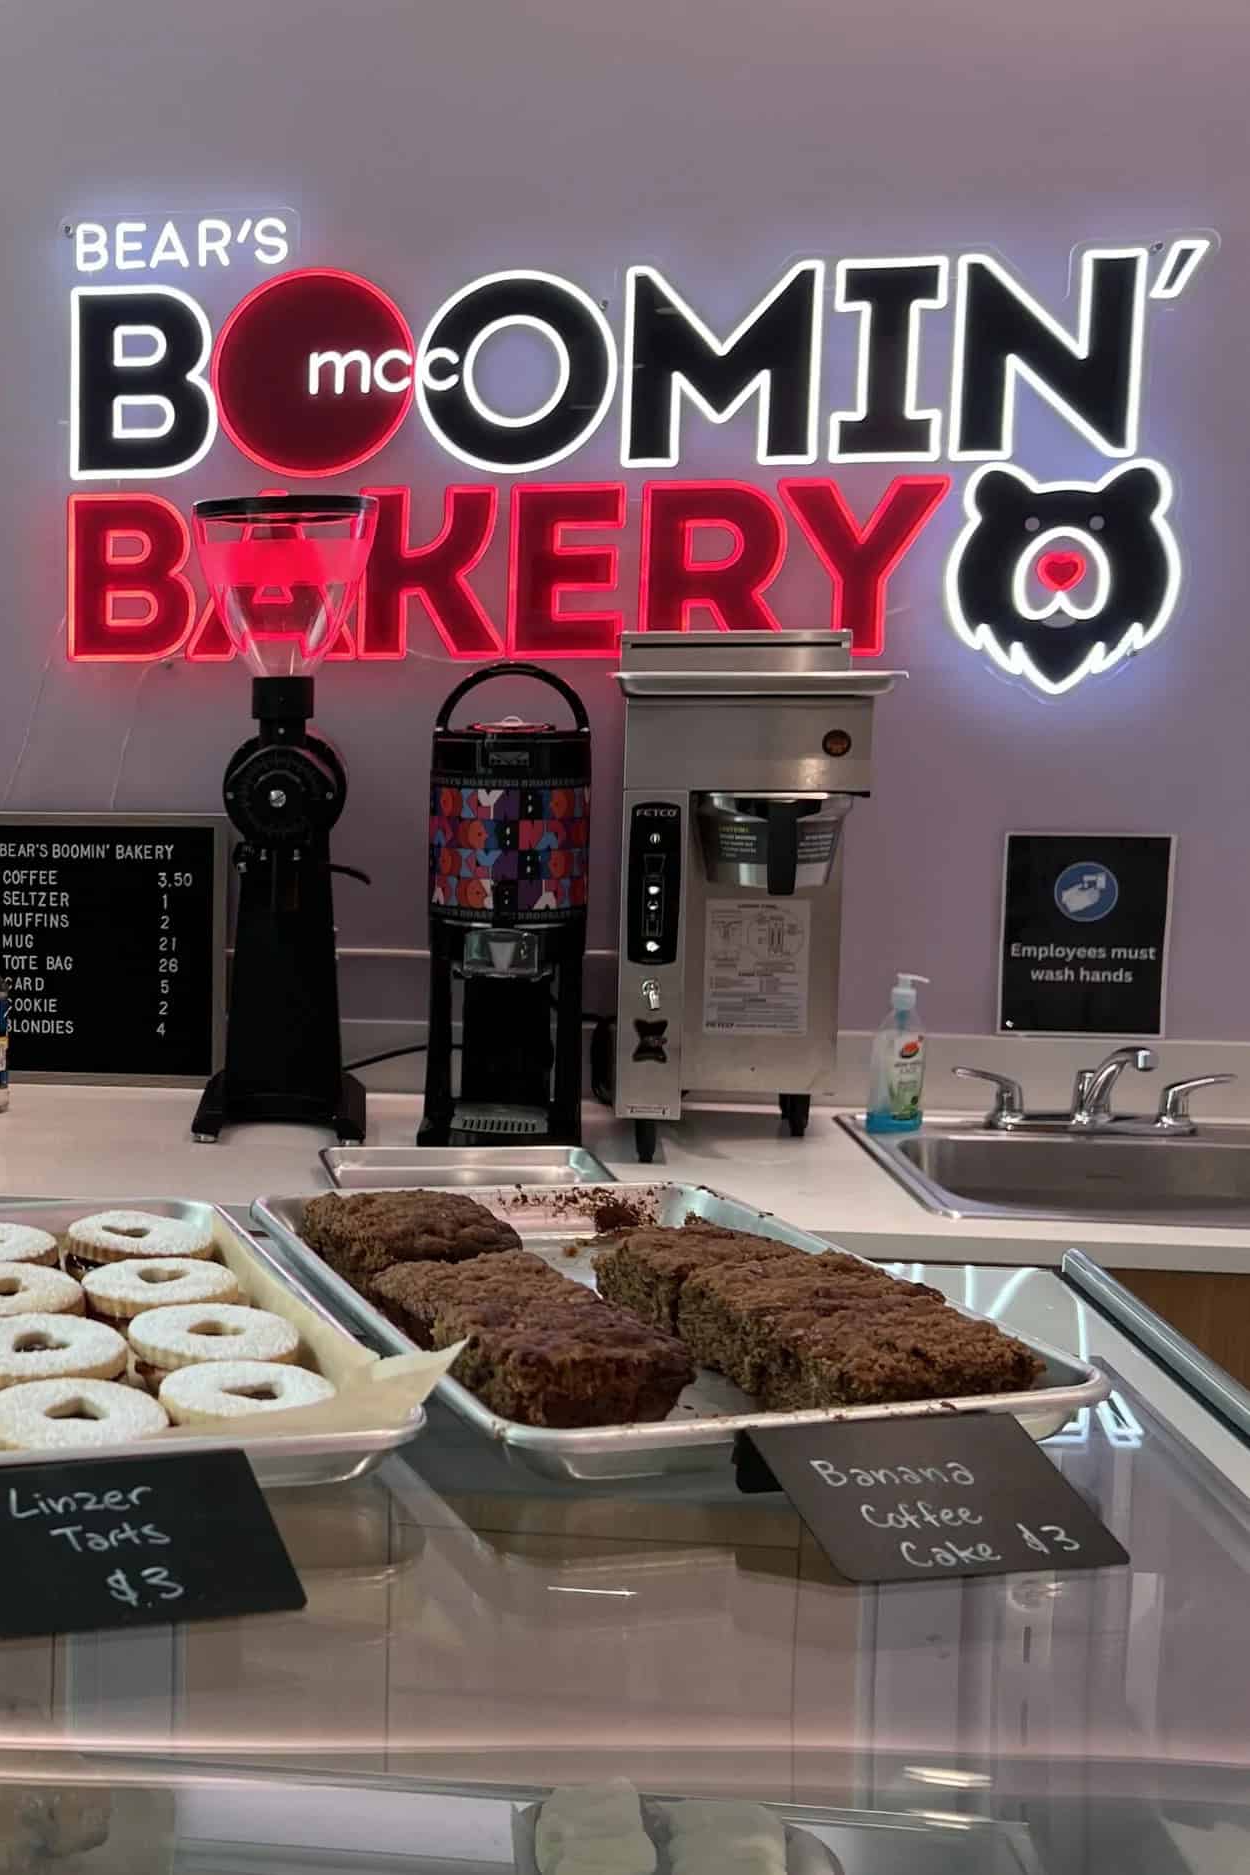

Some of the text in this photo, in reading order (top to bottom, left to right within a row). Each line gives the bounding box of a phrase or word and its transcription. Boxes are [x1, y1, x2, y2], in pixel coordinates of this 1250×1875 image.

[74, 217, 289, 272] BEAR'S
[308, 346, 461, 395] mcc
[66, 475, 951, 663] BAKERY
[0, 843, 174, 860] BEAR'S BOOMIN' BAKERY
[2, 870, 192, 888] COFFEE 3.50
[2, 892, 168, 909] SELTZER 1
[2, 913, 170, 930] MUFFINS 2
[2, 934, 176, 951] MUG 21
[1011, 943, 1156, 961] Employees must
[3, 955, 38, 970] TOTE
[46, 956, 73, 970] BAG
[1031, 968, 1133, 983] wash hands
[4, 977, 169, 993] CARD 5
[159, 1002, 168, 1015] 2
[156, 1022, 166, 1036] 4
[810, 1460, 975, 1487] Banana
[9, 1486, 152, 1518] Linzer
[860, 1501, 983, 1528] Coffee
[50, 1523, 171, 1551] Tarts
[900, 1523, 1080, 1567] Cake $3
